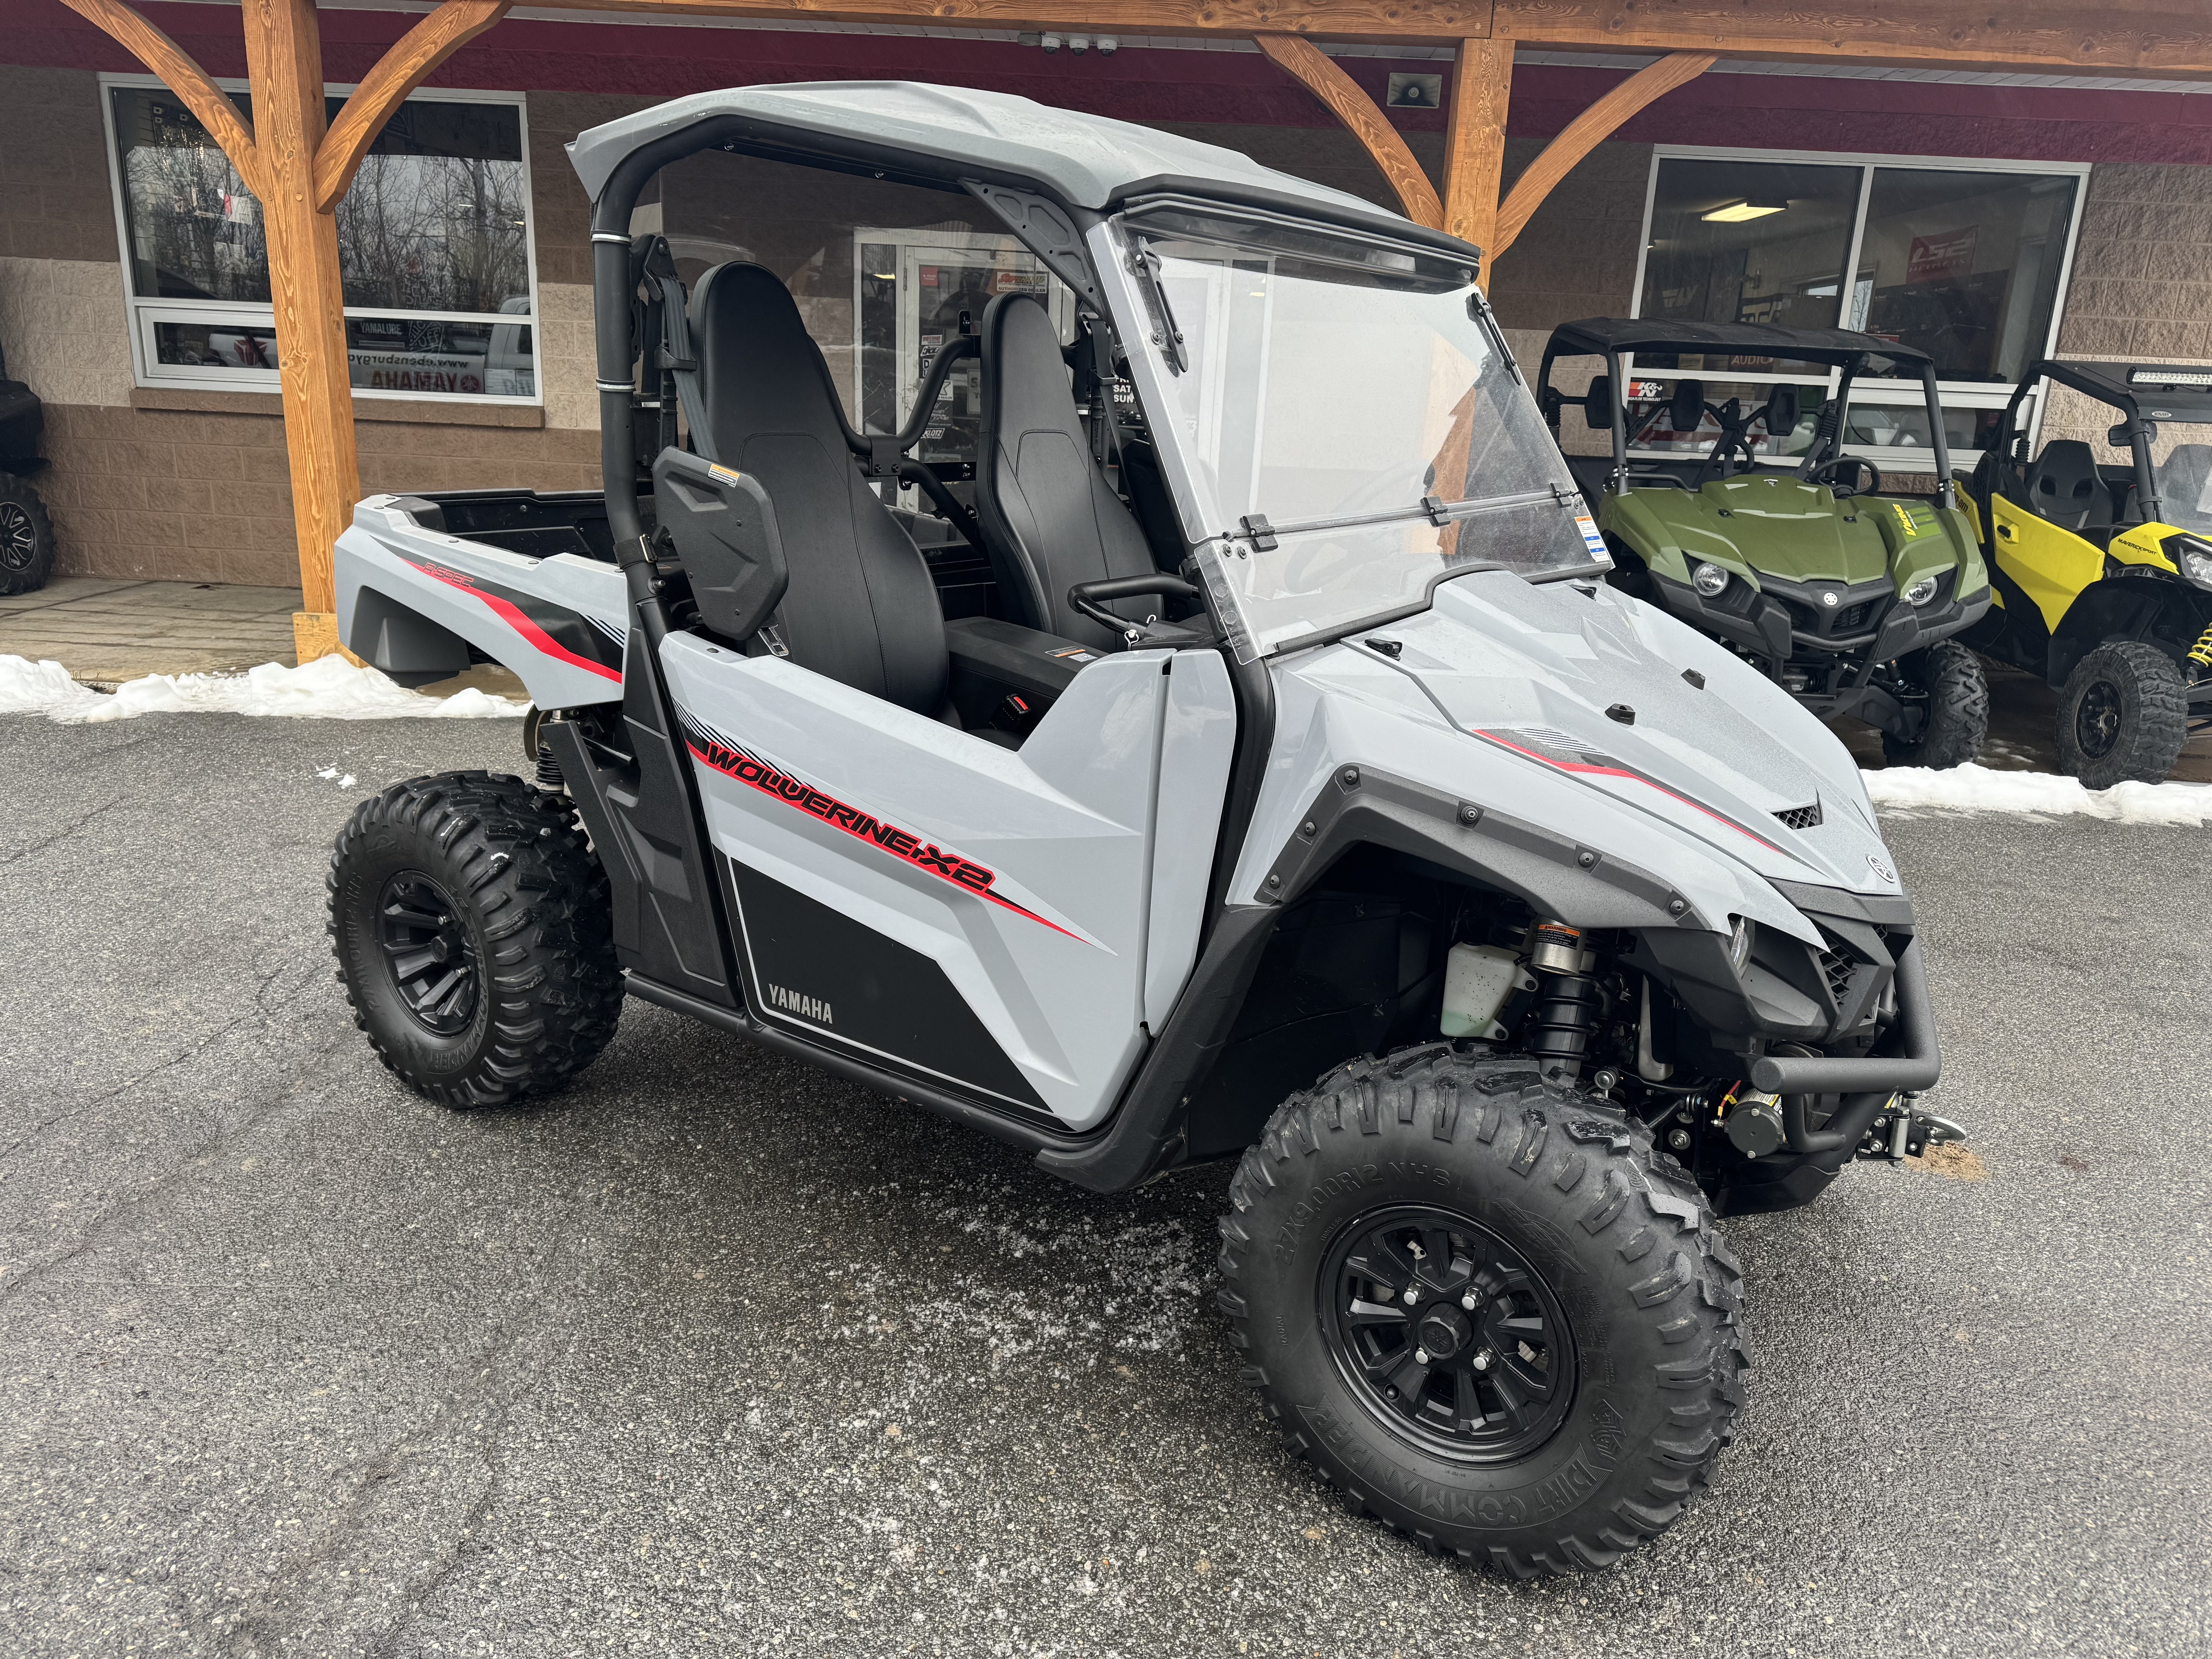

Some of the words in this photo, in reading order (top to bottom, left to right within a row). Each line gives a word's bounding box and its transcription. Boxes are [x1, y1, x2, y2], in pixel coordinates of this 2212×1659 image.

[1911, 238, 1975, 263] LS2
[360, 321, 403, 336] YAMALUBE
[1731, 355, 1774, 365] AUDIO
[1892, 503, 1917, 536] VIKING
[2118, 538, 2143, 551] MAVERICK
[769, 983, 833, 1025] YAMAHA
[1276, 1316, 1290, 1346] RADIAL
[1312, 1407, 1527, 1527] COMMANDER
[1534, 1457, 1597, 1517] DIRT
